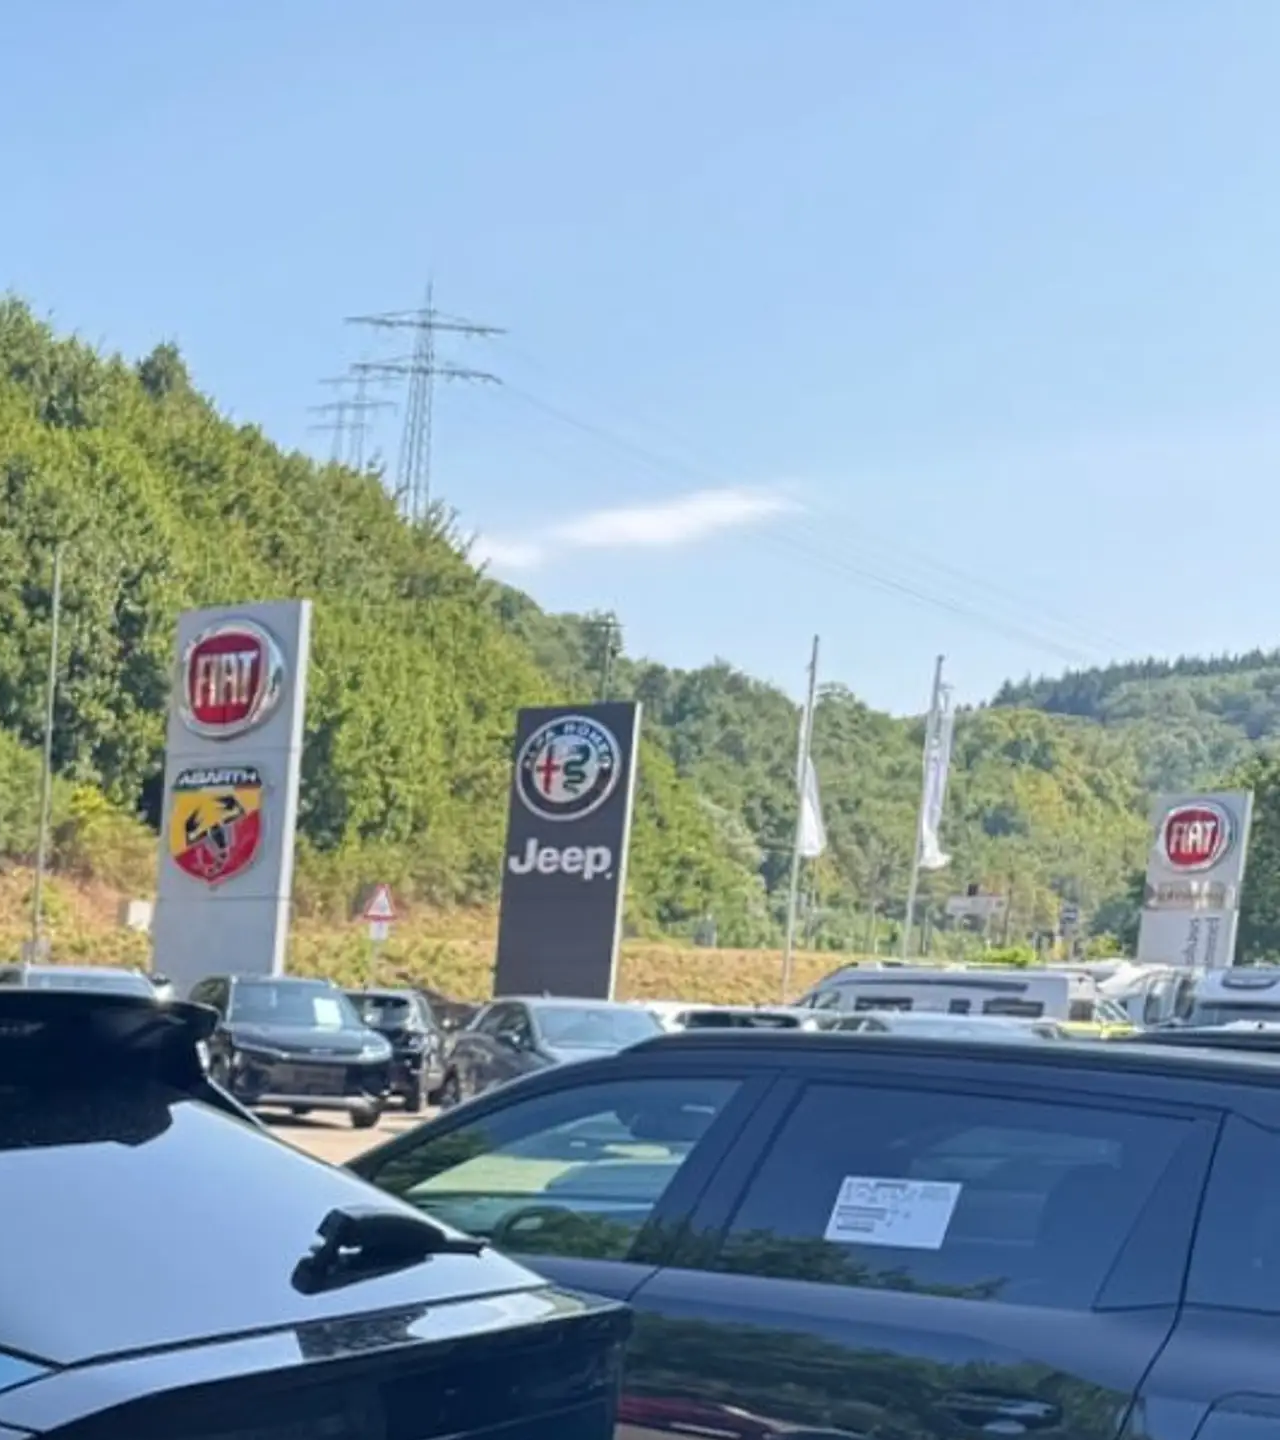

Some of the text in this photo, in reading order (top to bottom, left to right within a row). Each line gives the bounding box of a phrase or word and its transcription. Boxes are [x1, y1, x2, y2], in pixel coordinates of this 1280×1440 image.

[194, 649, 259, 709] FIAT
[178, 770, 258, 790] ABARTH
[1169, 819, 1218, 855] FIAT
[508, 836, 612, 881] Jeep
